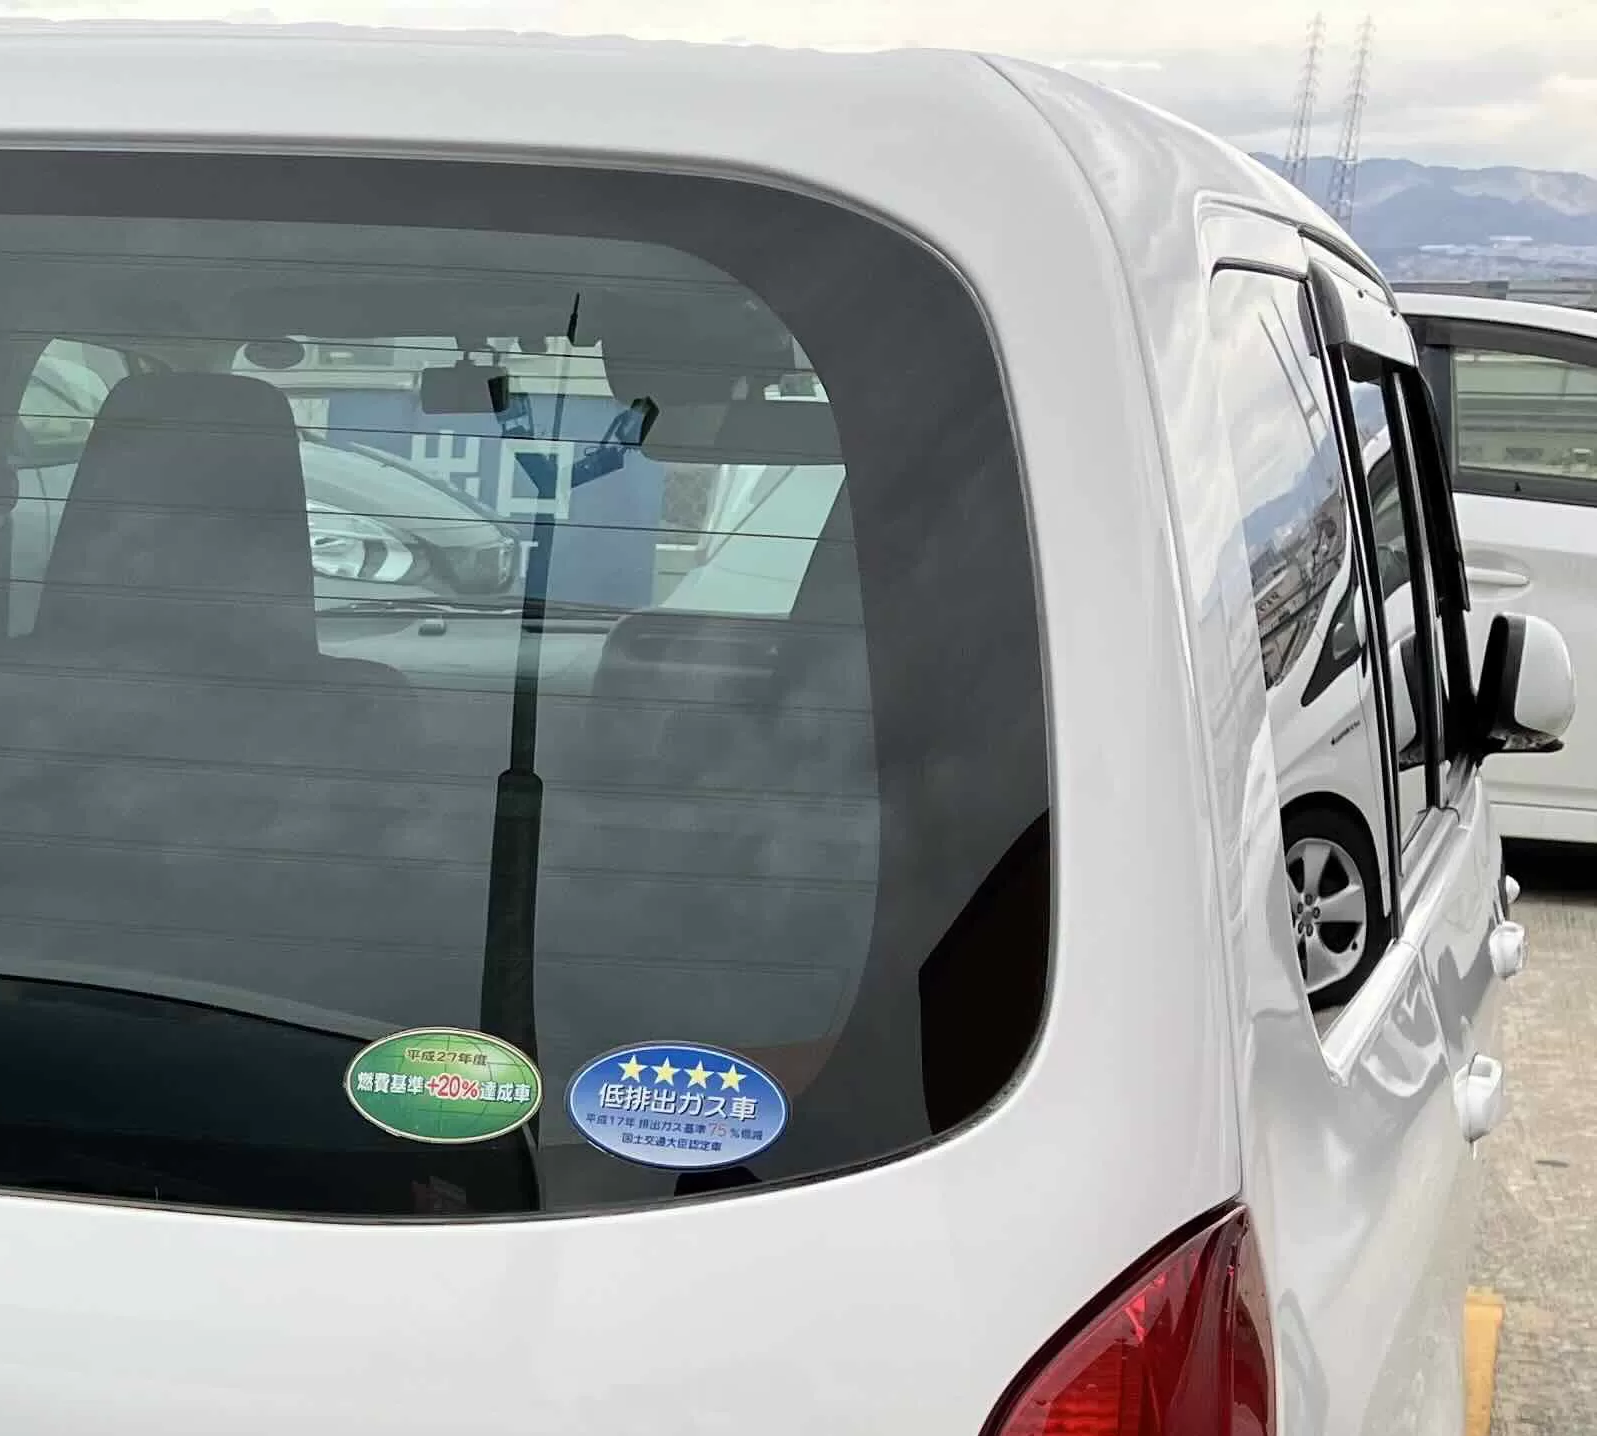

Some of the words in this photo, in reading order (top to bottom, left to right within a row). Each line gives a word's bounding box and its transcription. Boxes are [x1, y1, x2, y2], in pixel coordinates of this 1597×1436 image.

[407, 1050, 488, 1066] 平成27年度
[599, 1082, 758, 1121] 低排出ガス車
